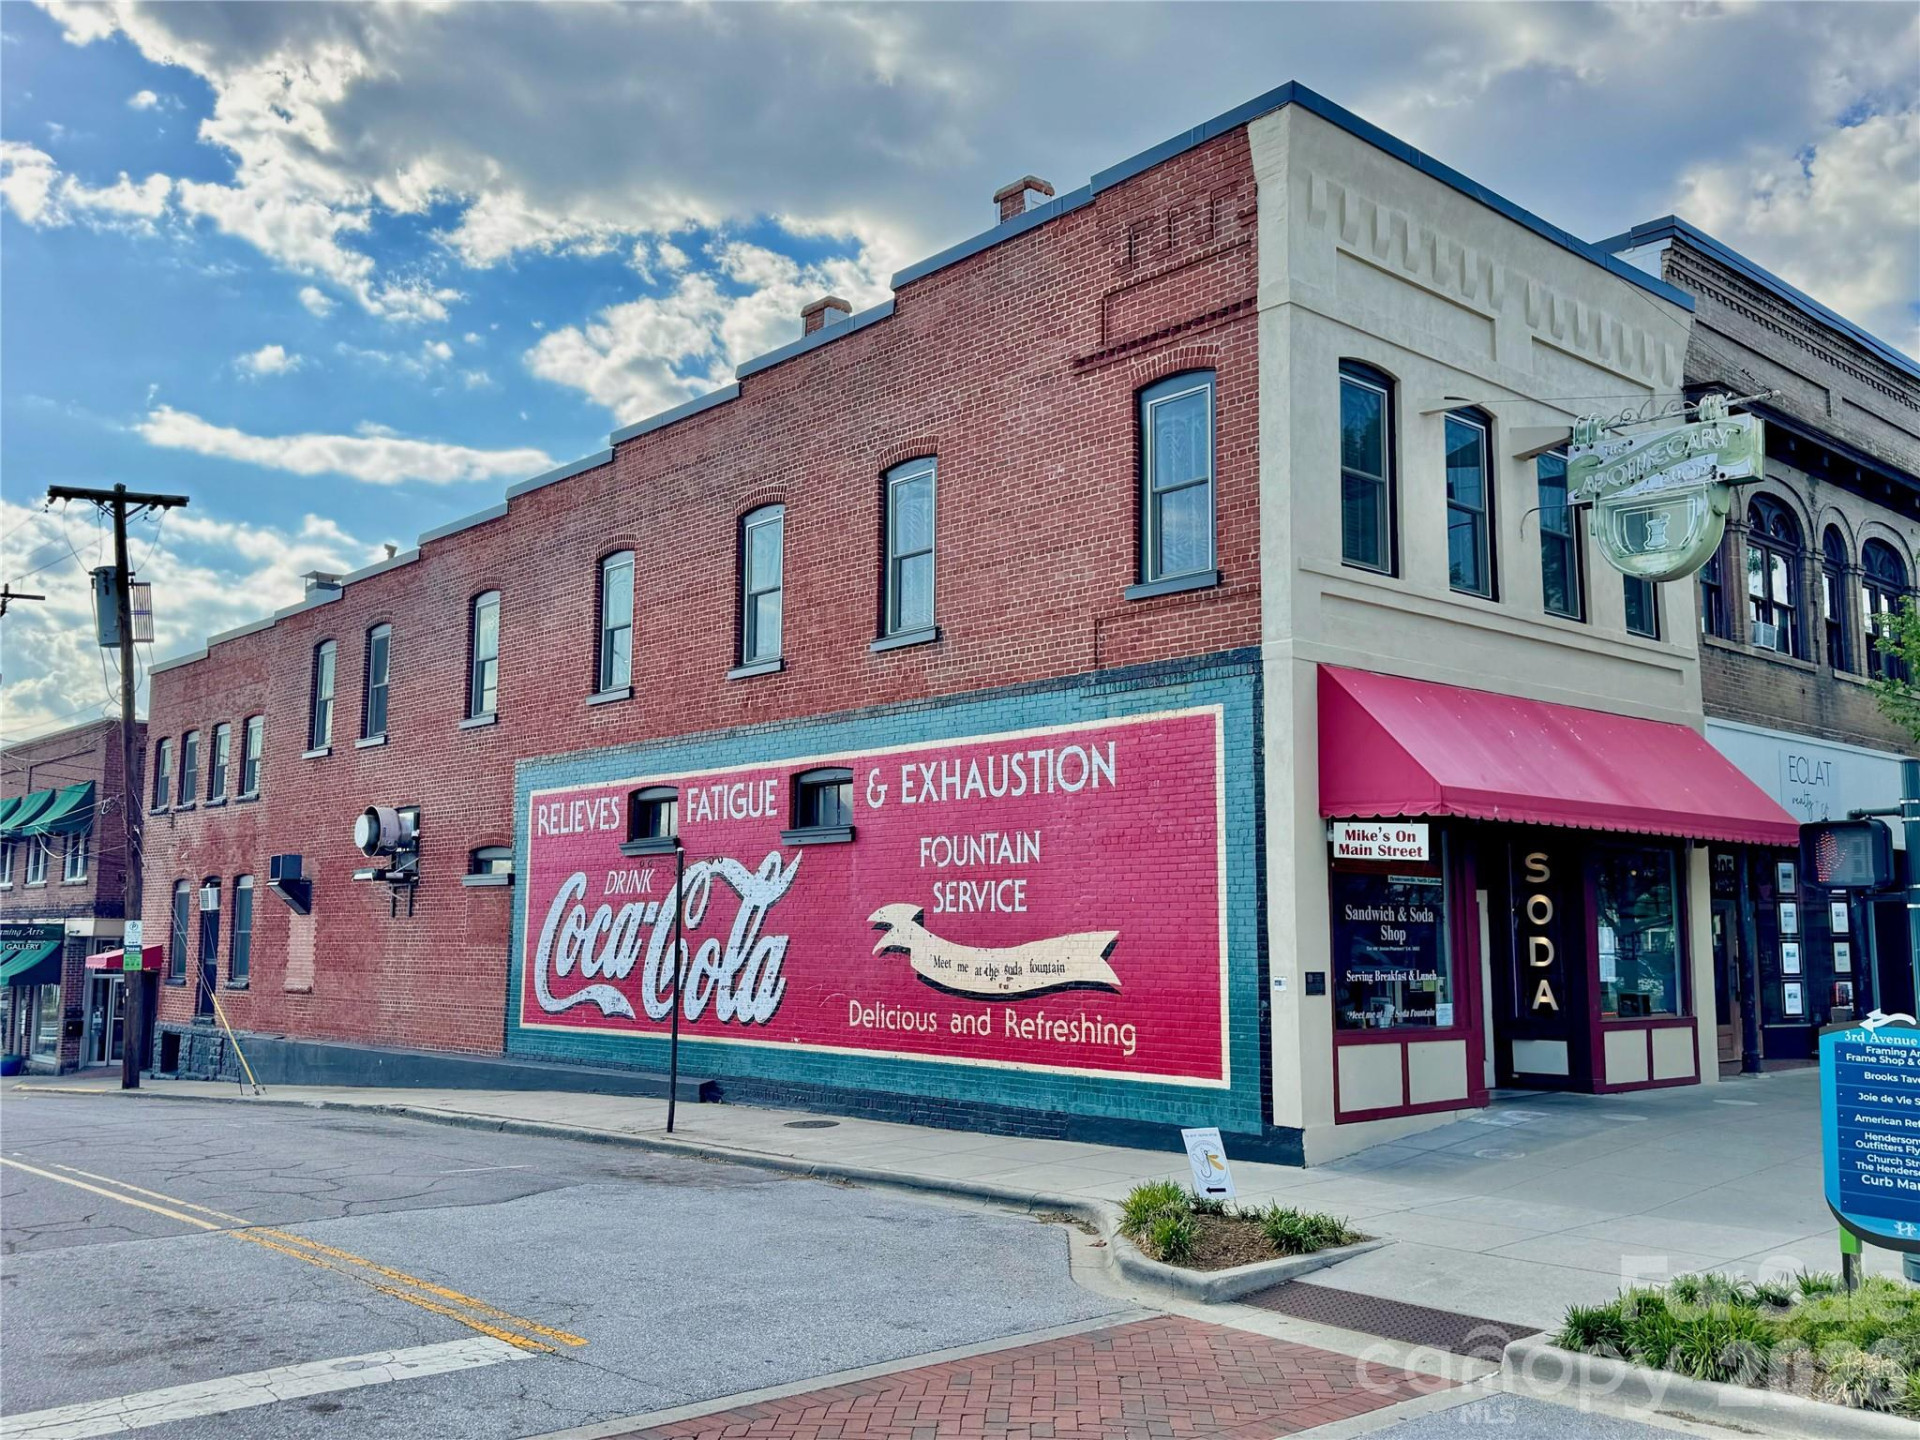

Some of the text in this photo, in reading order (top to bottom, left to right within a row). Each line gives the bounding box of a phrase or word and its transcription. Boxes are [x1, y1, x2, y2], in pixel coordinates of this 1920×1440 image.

[1788, 755, 1832, 787] ECLAT
[537, 741, 1116, 836] RELIEVES FATIGUE & EXHAUSTION
[1344, 826, 1416, 843] Mike's On
[919, 830, 1040, 868] FOUNTAIN
[1338, 843, 1423, 858] Main Street
[604, 868, 655, 895] DRINK
[932, 879, 1028, 913] SERVICE
[1345, 904, 1434, 923] Sandwich & Soda
[22, 926, 45, 936] Arts
[1380, 925, 1406, 945] Shop
[1525, 852, 1559, 1011] SODA
[6, 943, 40, 951] GALLERY
[957, 962, 969, 973] me
[974, 965, 982, 976] at
[1346, 970, 1437, 984] Serving Breakfast & Lunch
[849, 999, 1136, 1056] Delicious and Refreshing
[1844, 1031, 1918, 1046] 3rd Avenue
[1866, 1046, 1907, 1058] Framing
[1846, 1053, 1877, 1063] Frame
[1879, 1055, 1905, 1067] Shop
[1907, 1058, 1915, 1066] &
[1864, 1071, 1898, 1082] Brooks
[1858, 1092, 1878, 1102] Joie
[1880, 1094, 1893, 1103] de
[1895, 1096, 1912, 1105] Vie
[1854, 1113, 1902, 1126] American
[1855, 1140, 1903, 1152] Outfitters
[1855, 1161, 1874, 1171] The
[1867, 1154, 1903, 1166] Church
[1861, 1174, 1894, 1187] Curb
